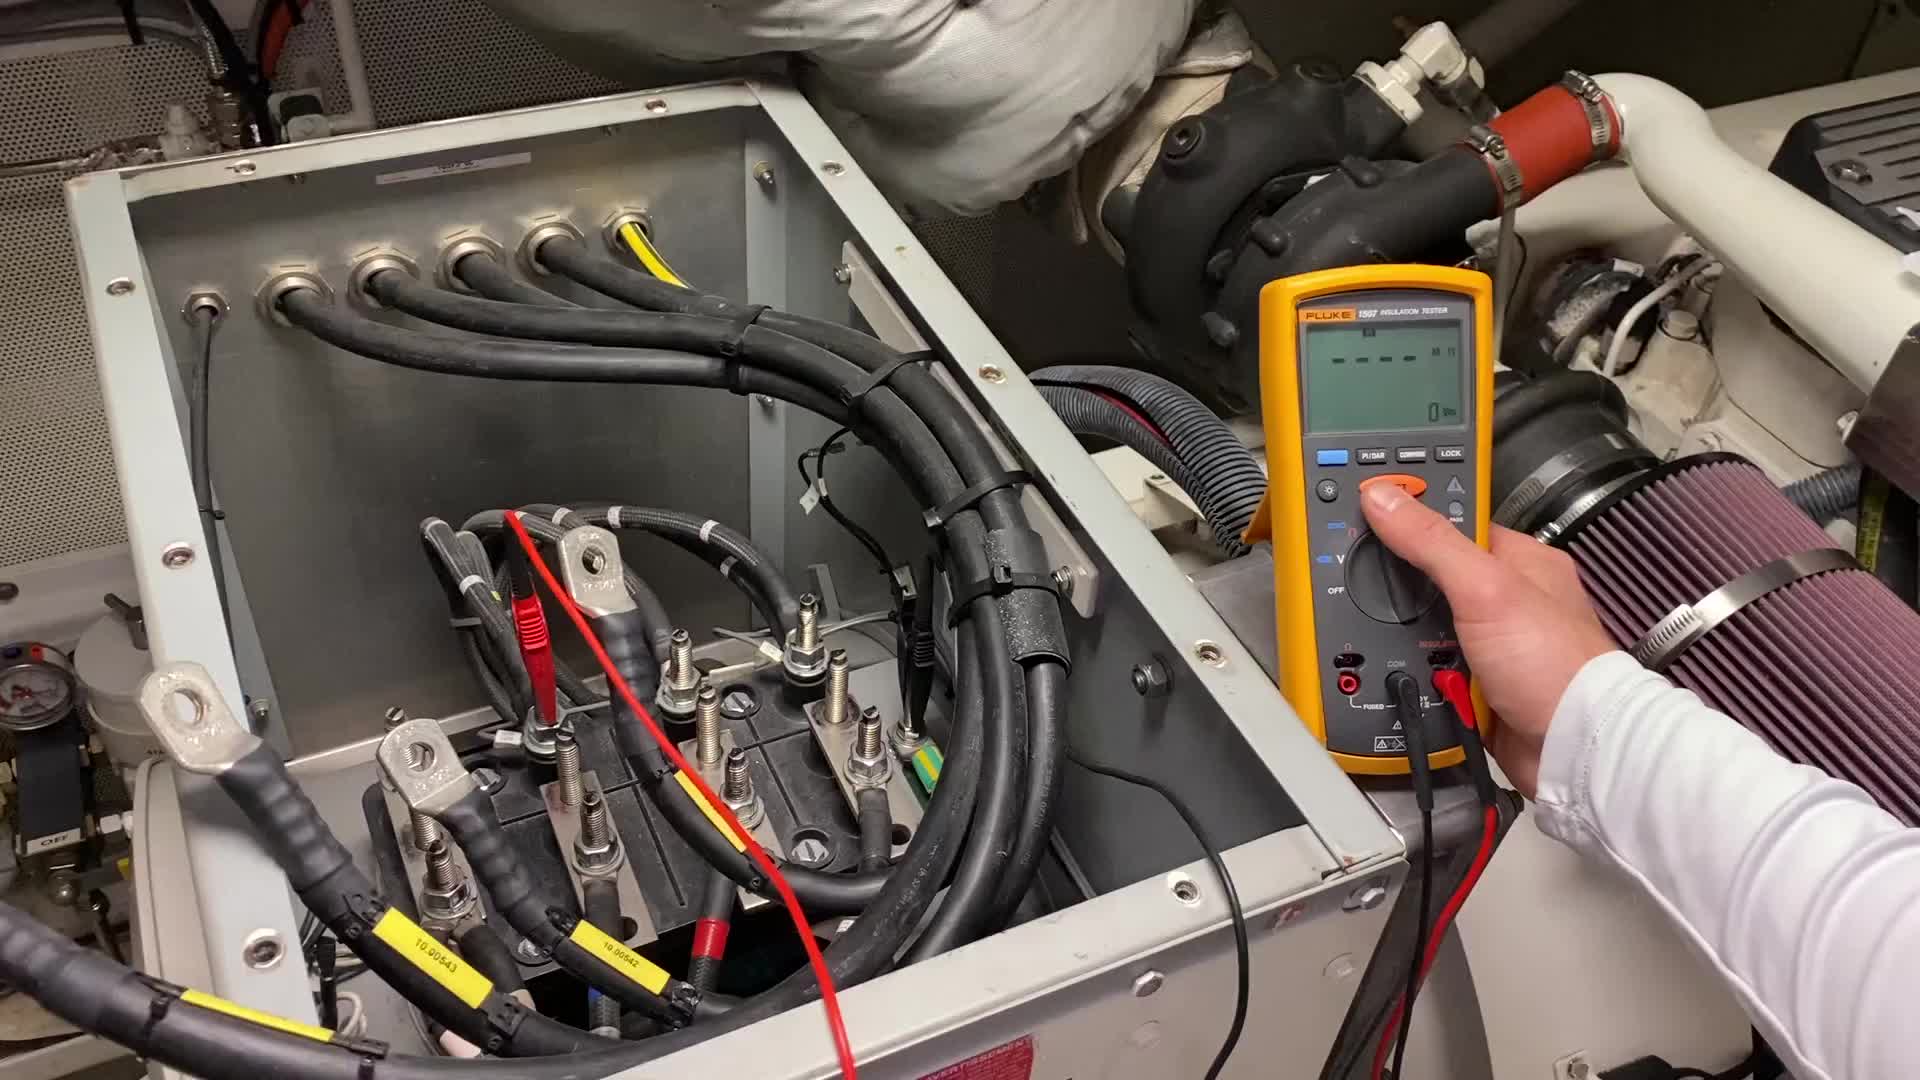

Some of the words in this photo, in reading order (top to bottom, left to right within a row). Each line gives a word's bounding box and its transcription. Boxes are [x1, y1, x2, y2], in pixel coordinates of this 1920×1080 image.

[1305, 311, 1352, 320] FLUKE
[1421, 307, 1448, 315] TESTER
[1441, 449, 1462, 458] LOCK
[1327, 586, 1345, 595] OFF
[1386, 660, 1406, 668] COM
[415, 937, 458, 974] 10.00543
